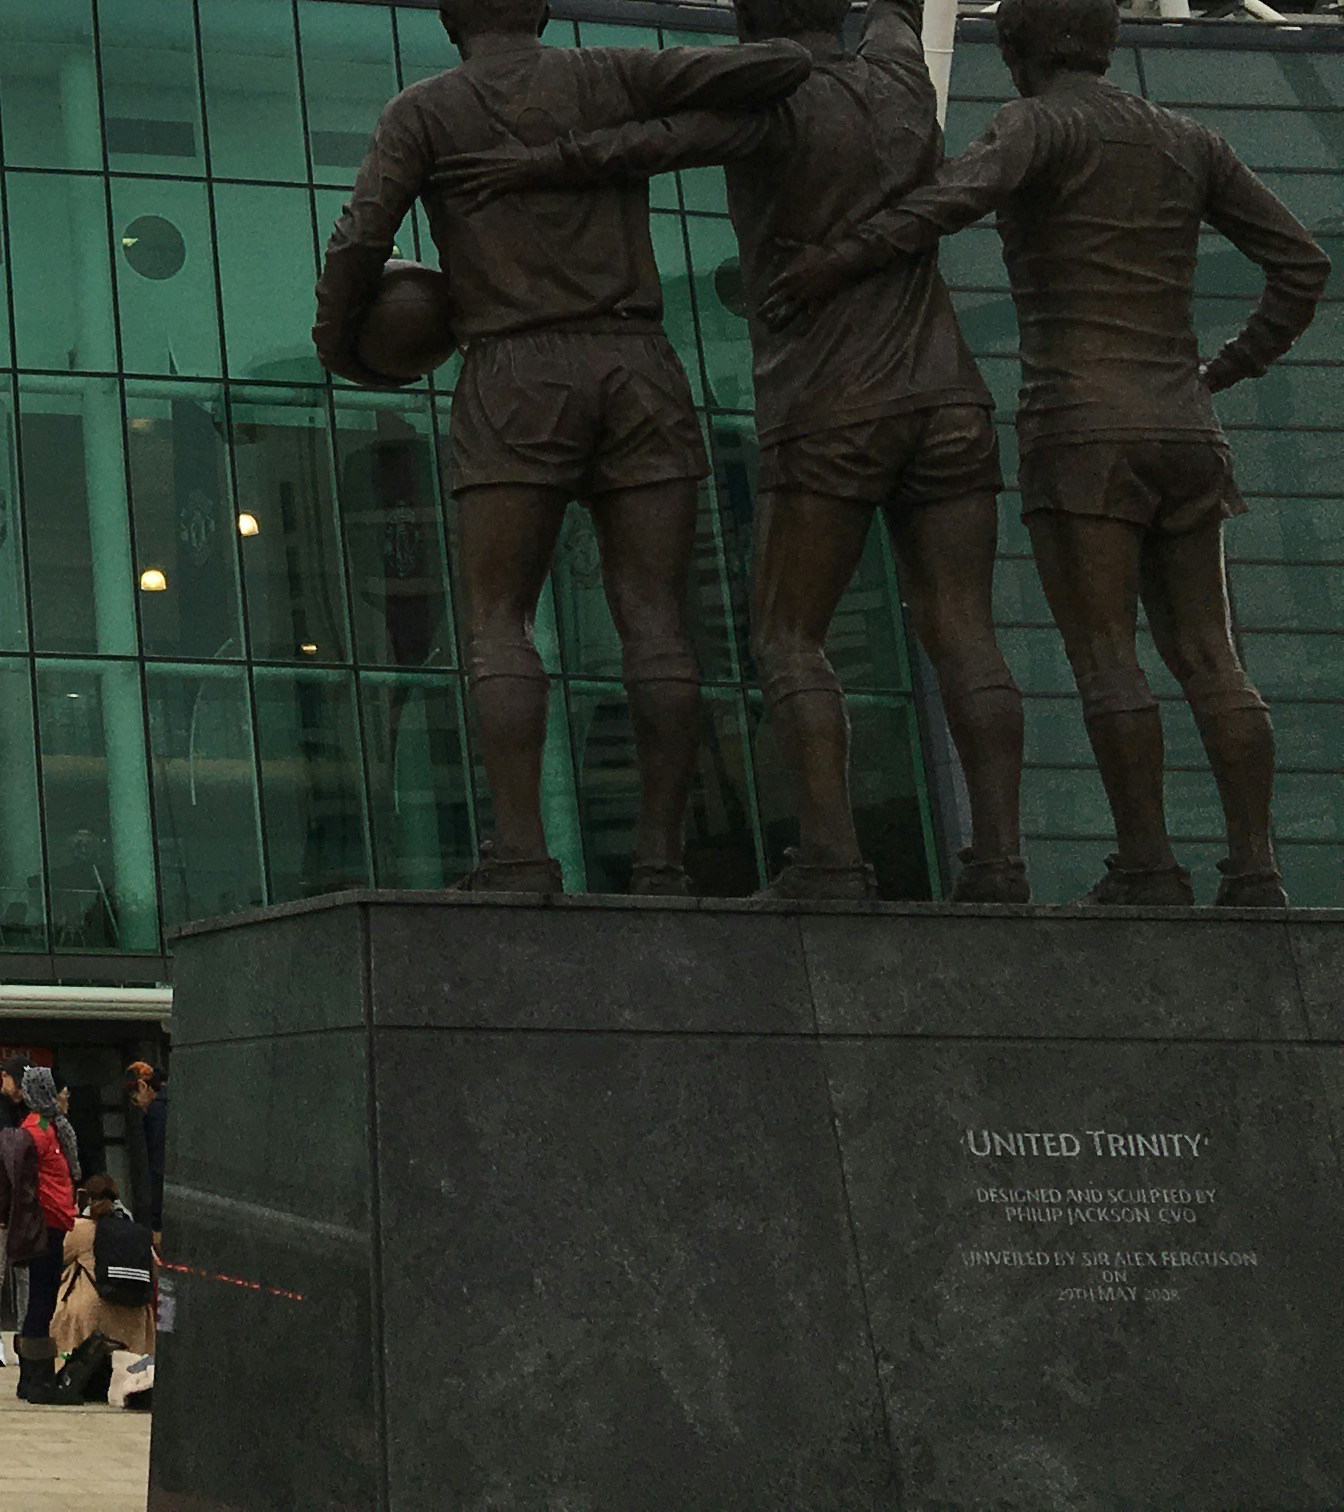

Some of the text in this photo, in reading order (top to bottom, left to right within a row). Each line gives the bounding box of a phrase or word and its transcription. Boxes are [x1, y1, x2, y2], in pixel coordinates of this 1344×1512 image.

[976, 1188, 1217, 1204] DESIGNED AND SCULPTED BY
[1004, 1207, 1063, 1223] PHILIP
[962, 1250, 1259, 1267] UNVEILED BY SIR ALEX FERGUSON
[1101, 1269, 1128, 1284] ON
[1097, 1286, 1138, 1302] MAY
